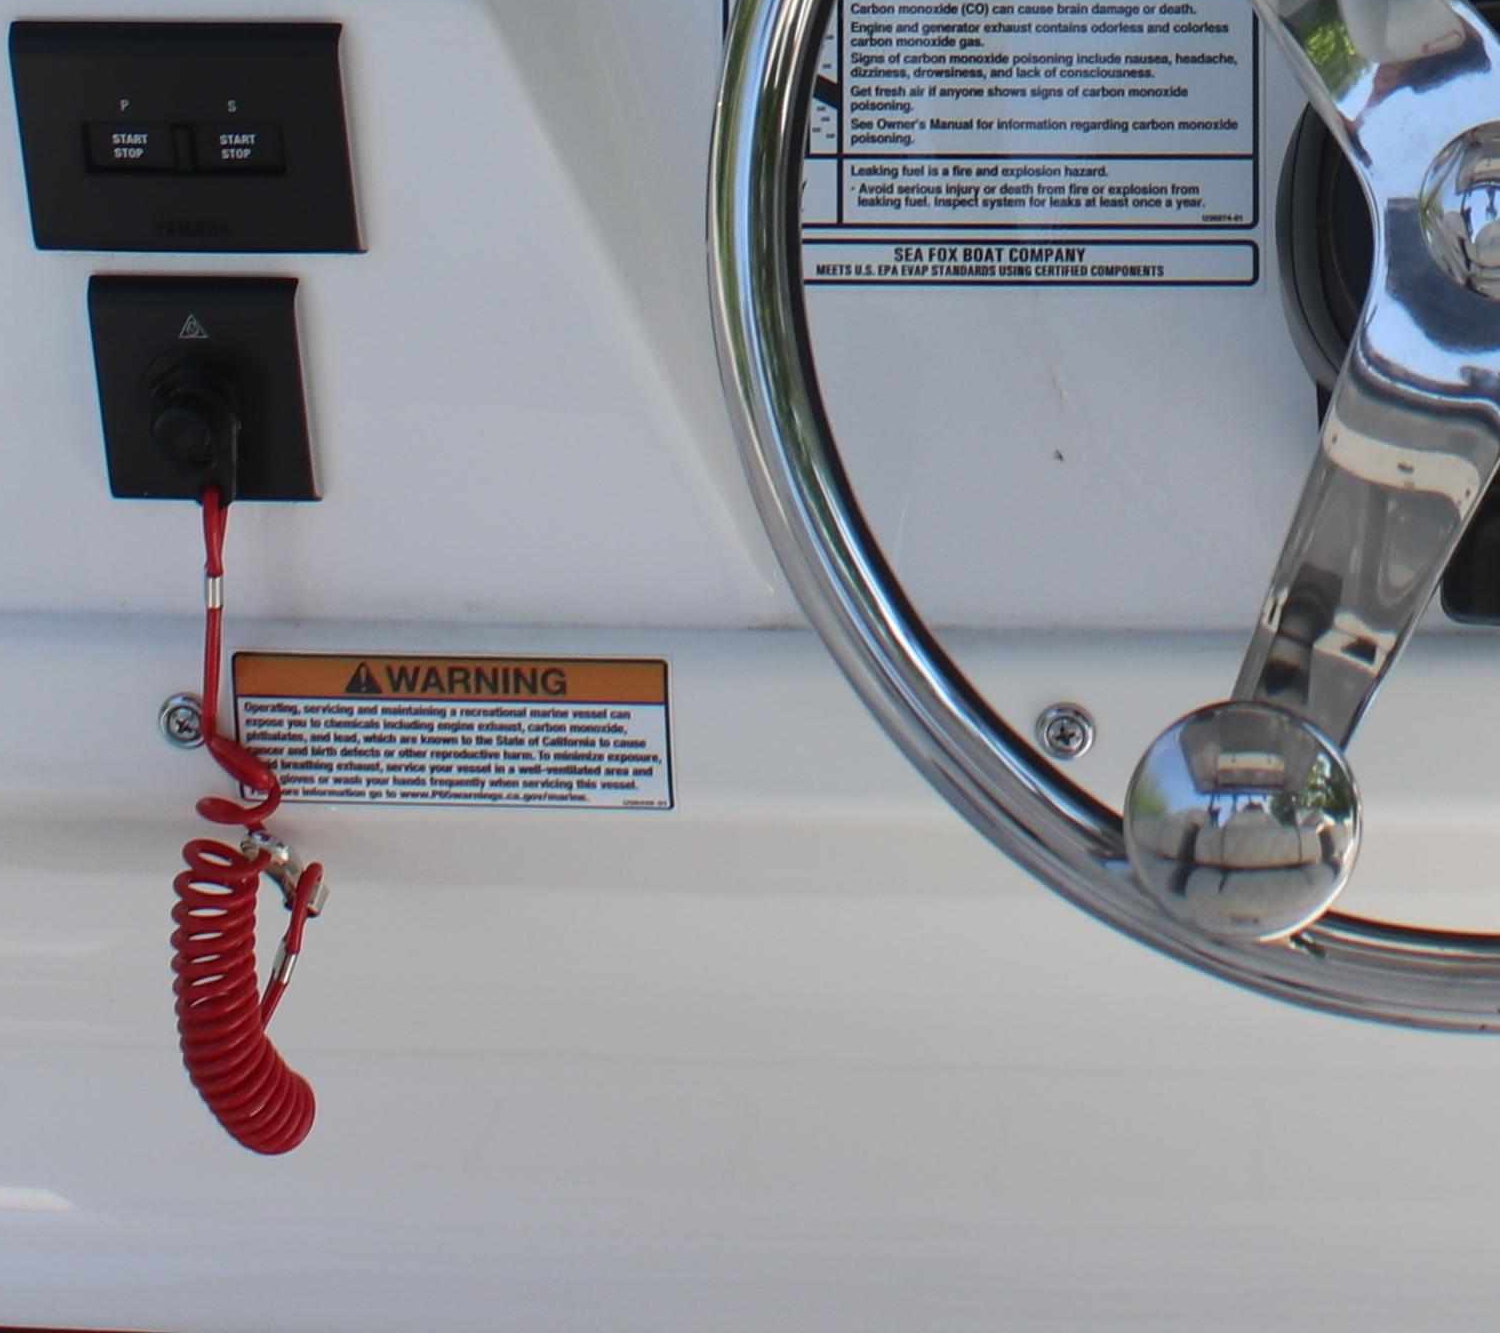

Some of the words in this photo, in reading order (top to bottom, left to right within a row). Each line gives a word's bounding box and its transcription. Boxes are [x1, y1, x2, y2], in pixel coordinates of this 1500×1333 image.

[120, 99, 129, 111] P
[227, 100, 237, 113] S
[112, 133, 148, 144] START
[219, 134, 256, 145] START
[114, 148, 143, 158] STOP
[221, 148, 251, 159] STOP
[894, 248, 923, 262] SEA
[928, 248, 958, 262] FOX
[963, 248, 1004, 262] BOAT
[1008, 247, 1086, 263] COMPANY
[816, 264, 851, 276] MEETS
[854, 264, 875, 276] U.S.
[878, 264, 898, 276] EPA
[901, 264, 928, 276] EVAP
[932, 265, 996, 276] STANDARDS
[999, 265, 1032, 276] USING
[1035, 265, 1088, 276] CERTIFIED
[1090, 265, 1164, 277] COMPONENTS
[386, 665, 568, 696] WARNING
